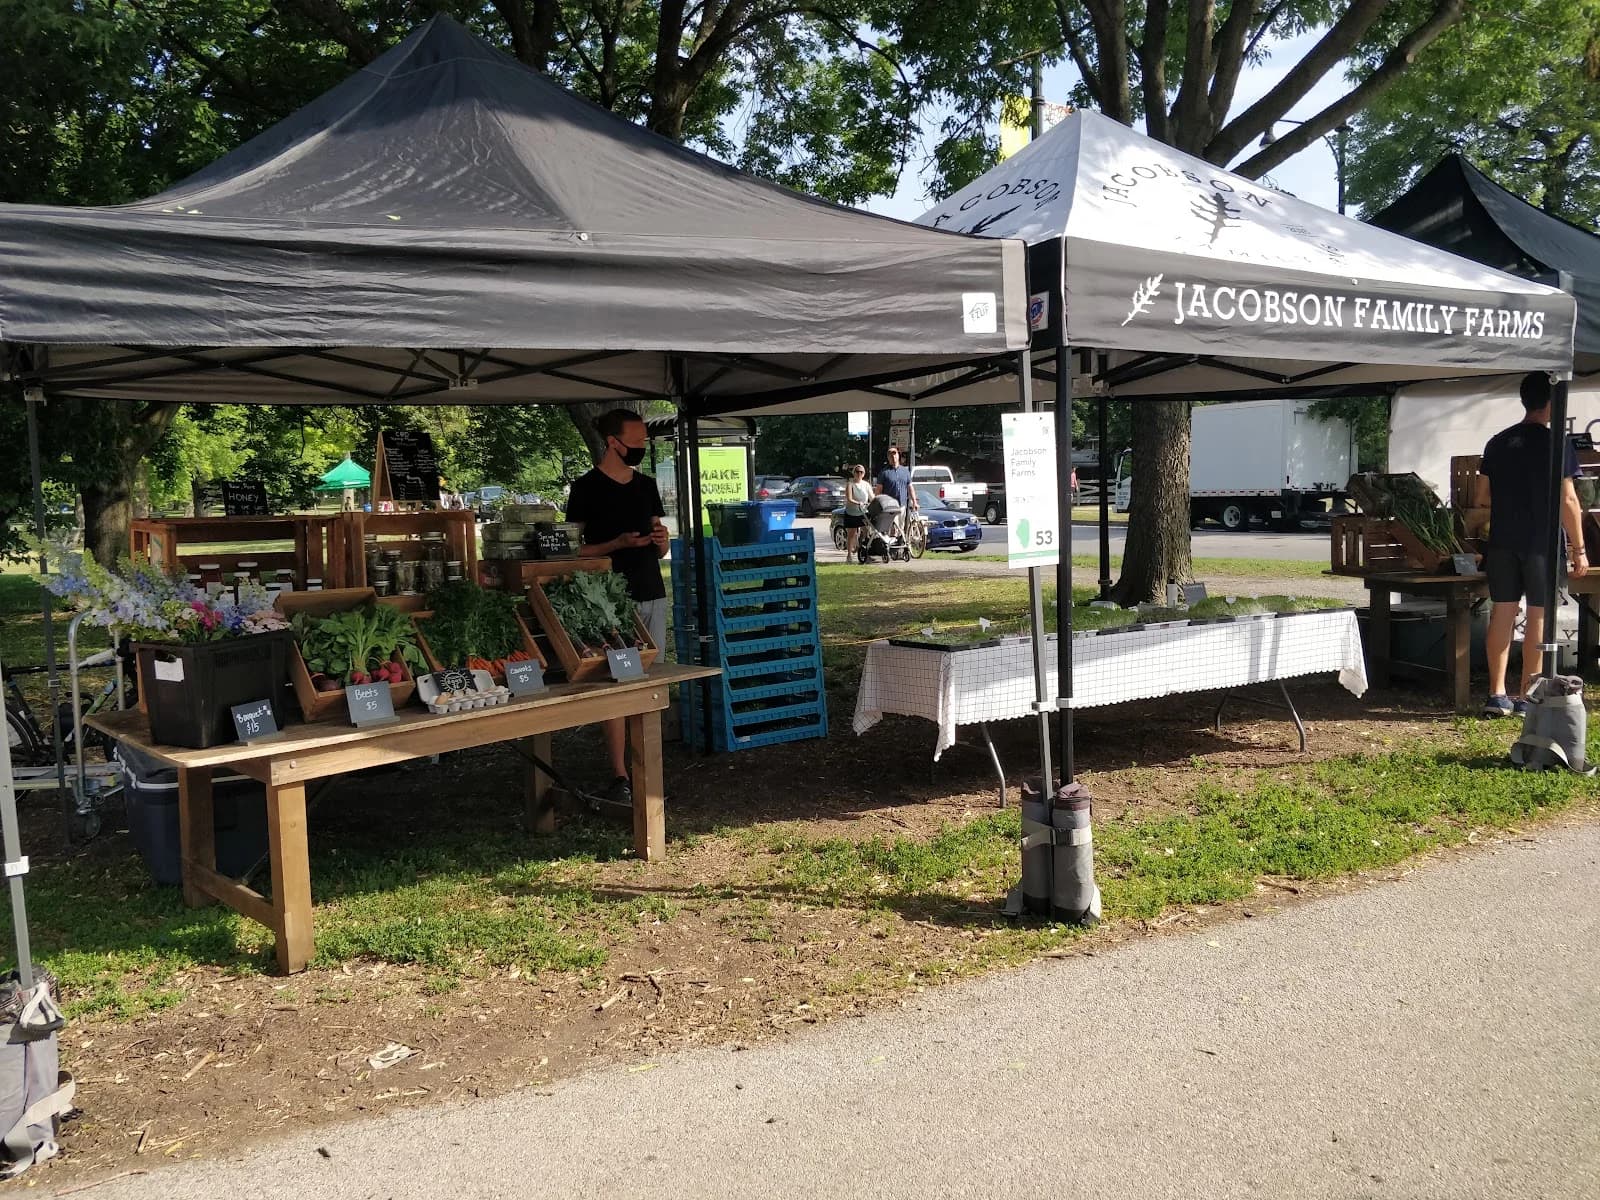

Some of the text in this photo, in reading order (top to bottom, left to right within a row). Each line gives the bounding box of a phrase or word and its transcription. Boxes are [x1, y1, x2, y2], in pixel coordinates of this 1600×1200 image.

[1174, 282, 1545, 339] JACOBSON FAMILY FARMS
[1010, 447, 1047, 456] Jacobson
[1011, 458, 1036, 468] Family
[701, 469, 741, 480] MAKE
[1011, 469, 1036, 478] Farms
[701, 483, 742, 495] OURSELF
[228, 491, 259, 503] HONEY
[1036, 530, 1053, 546] 53
[354, 688, 379, 701] Beets
[366, 700, 378, 711] $5
[246, 721, 260, 735] $15
